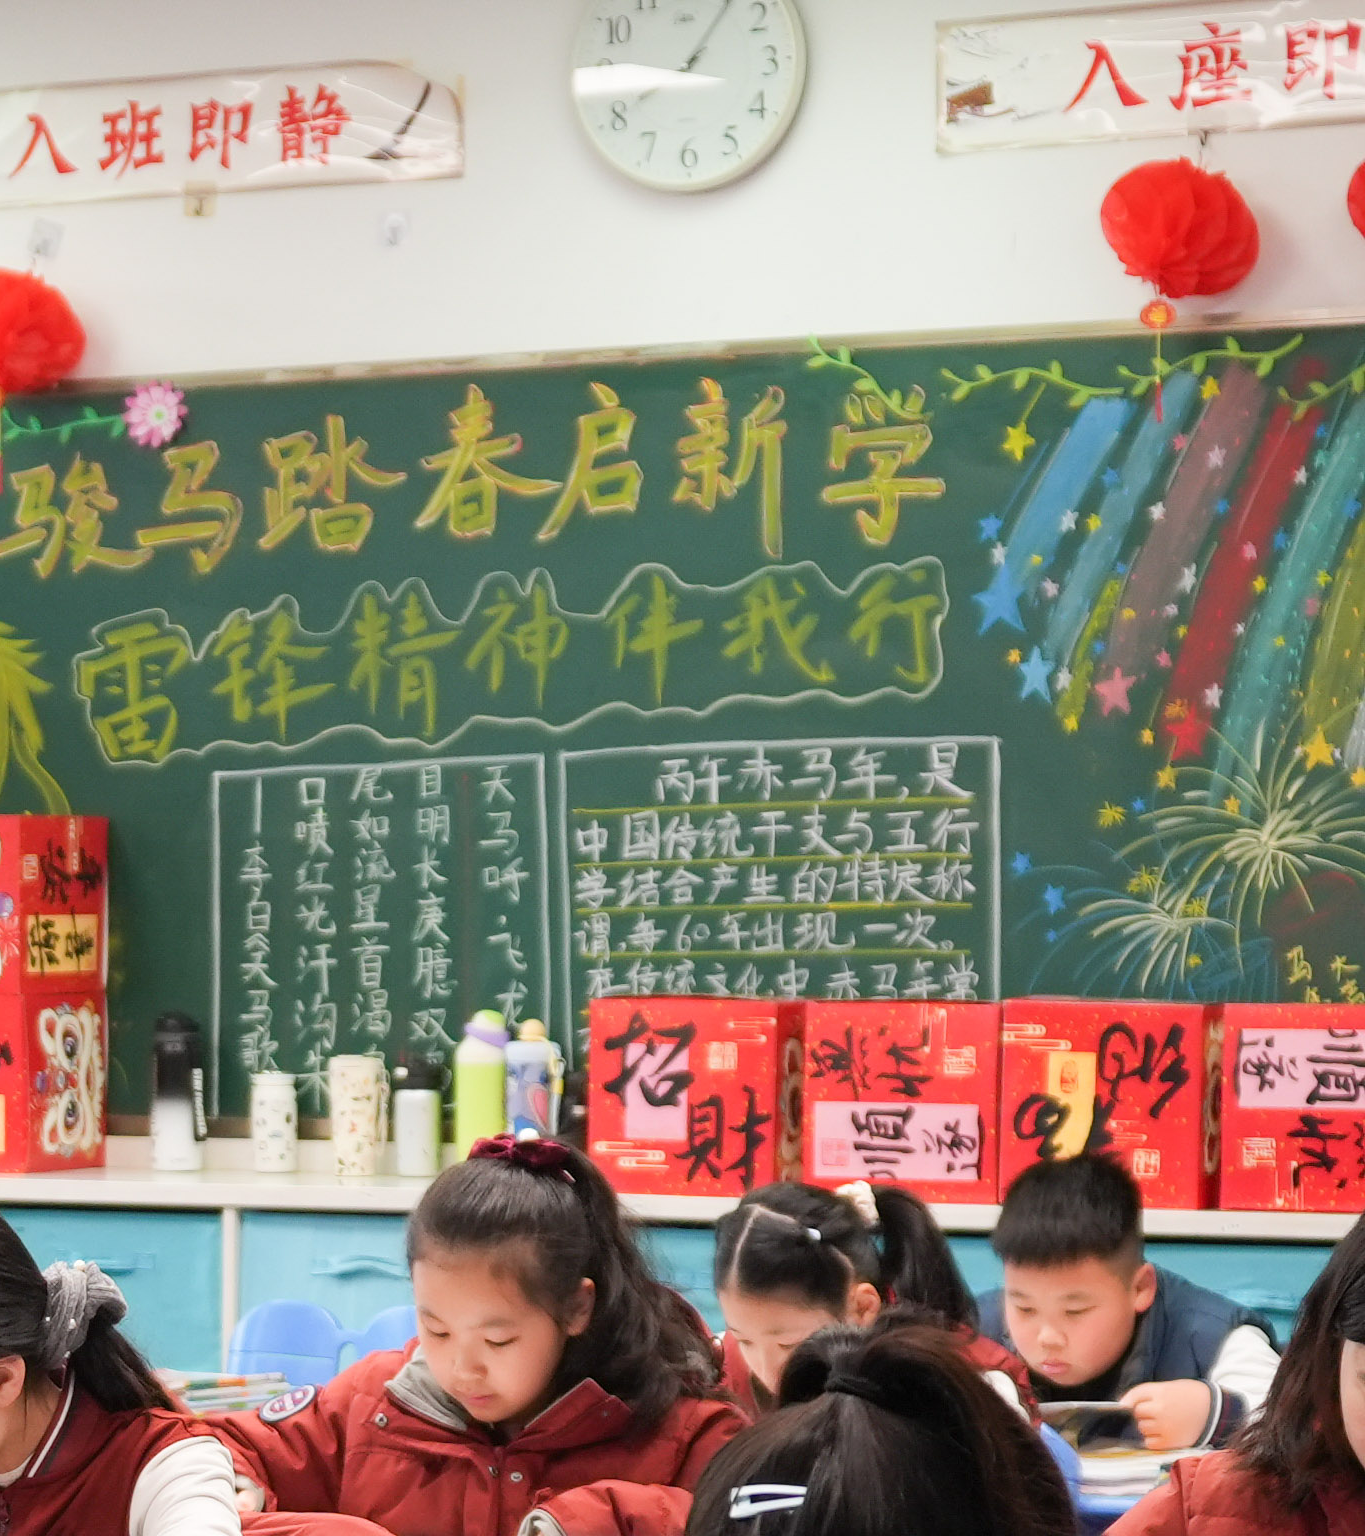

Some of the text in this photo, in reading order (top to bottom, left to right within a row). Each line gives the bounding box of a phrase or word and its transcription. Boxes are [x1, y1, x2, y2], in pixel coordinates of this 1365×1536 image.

[605, 14, 631, 44] 10
[750, 2, 767, 31] 2
[762, 44, 779, 76] 3
[1063, 18, 1363, 112] 入座即
[611, 100, 628, 131] 8
[748, 89, 768, 120] 4
[8, 83, 353, 180] 入班即静
[640, 131, 657, 163] 7
[721, 125, 739, 156] 5
[680, 136, 699, 168] 6
[79, 565, 941, 760] 雷锋精神伴我行
[576, 804, 979, 862] 中国传统干支与五行
[575, 852, 976, 909] 学结合产生的特定称
